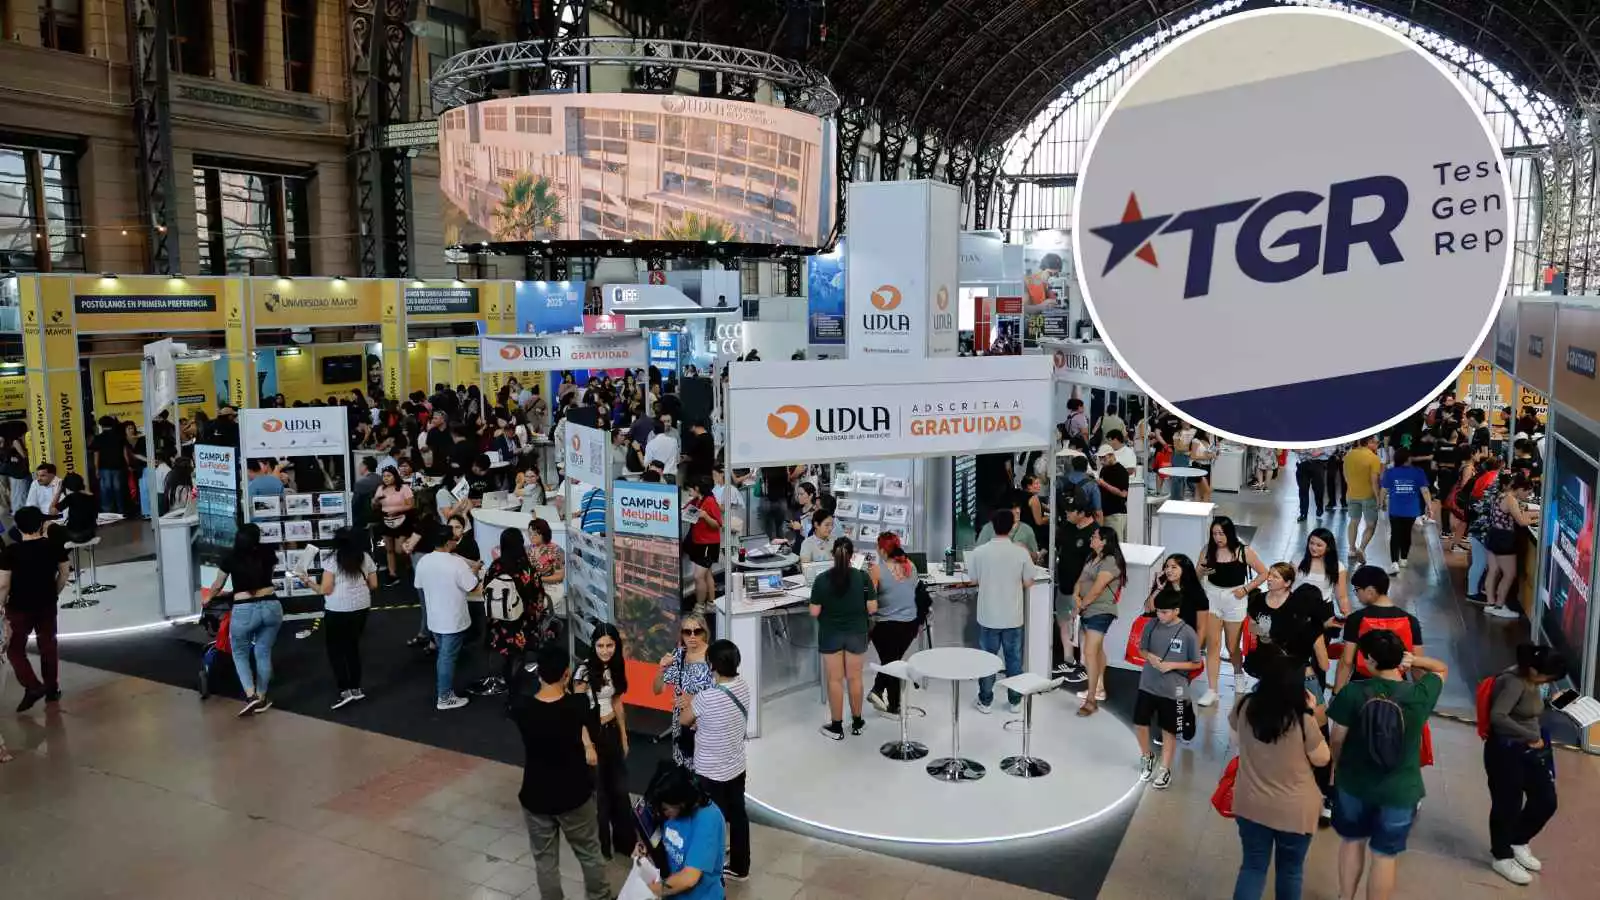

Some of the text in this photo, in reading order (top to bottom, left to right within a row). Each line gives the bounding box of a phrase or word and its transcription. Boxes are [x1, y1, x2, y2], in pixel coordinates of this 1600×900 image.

[138, 299, 167, 308] PRIMERA
[167, 299, 208, 308] PREFERENCIA
[863, 314, 910, 331] UDLA
[523, 344, 561, 358] UDLA
[570, 351, 630, 360] GRATUIDAD
[912, 400, 1020, 413] ADSCRITA A
[284, 418, 321, 431] UDLA
[816, 406, 891, 434] UDLA
[910, 414, 1022, 436] GRATUIDAD
[199, 451, 230, 462] CAMPUS
[620, 496, 670, 511] CAMPUS
